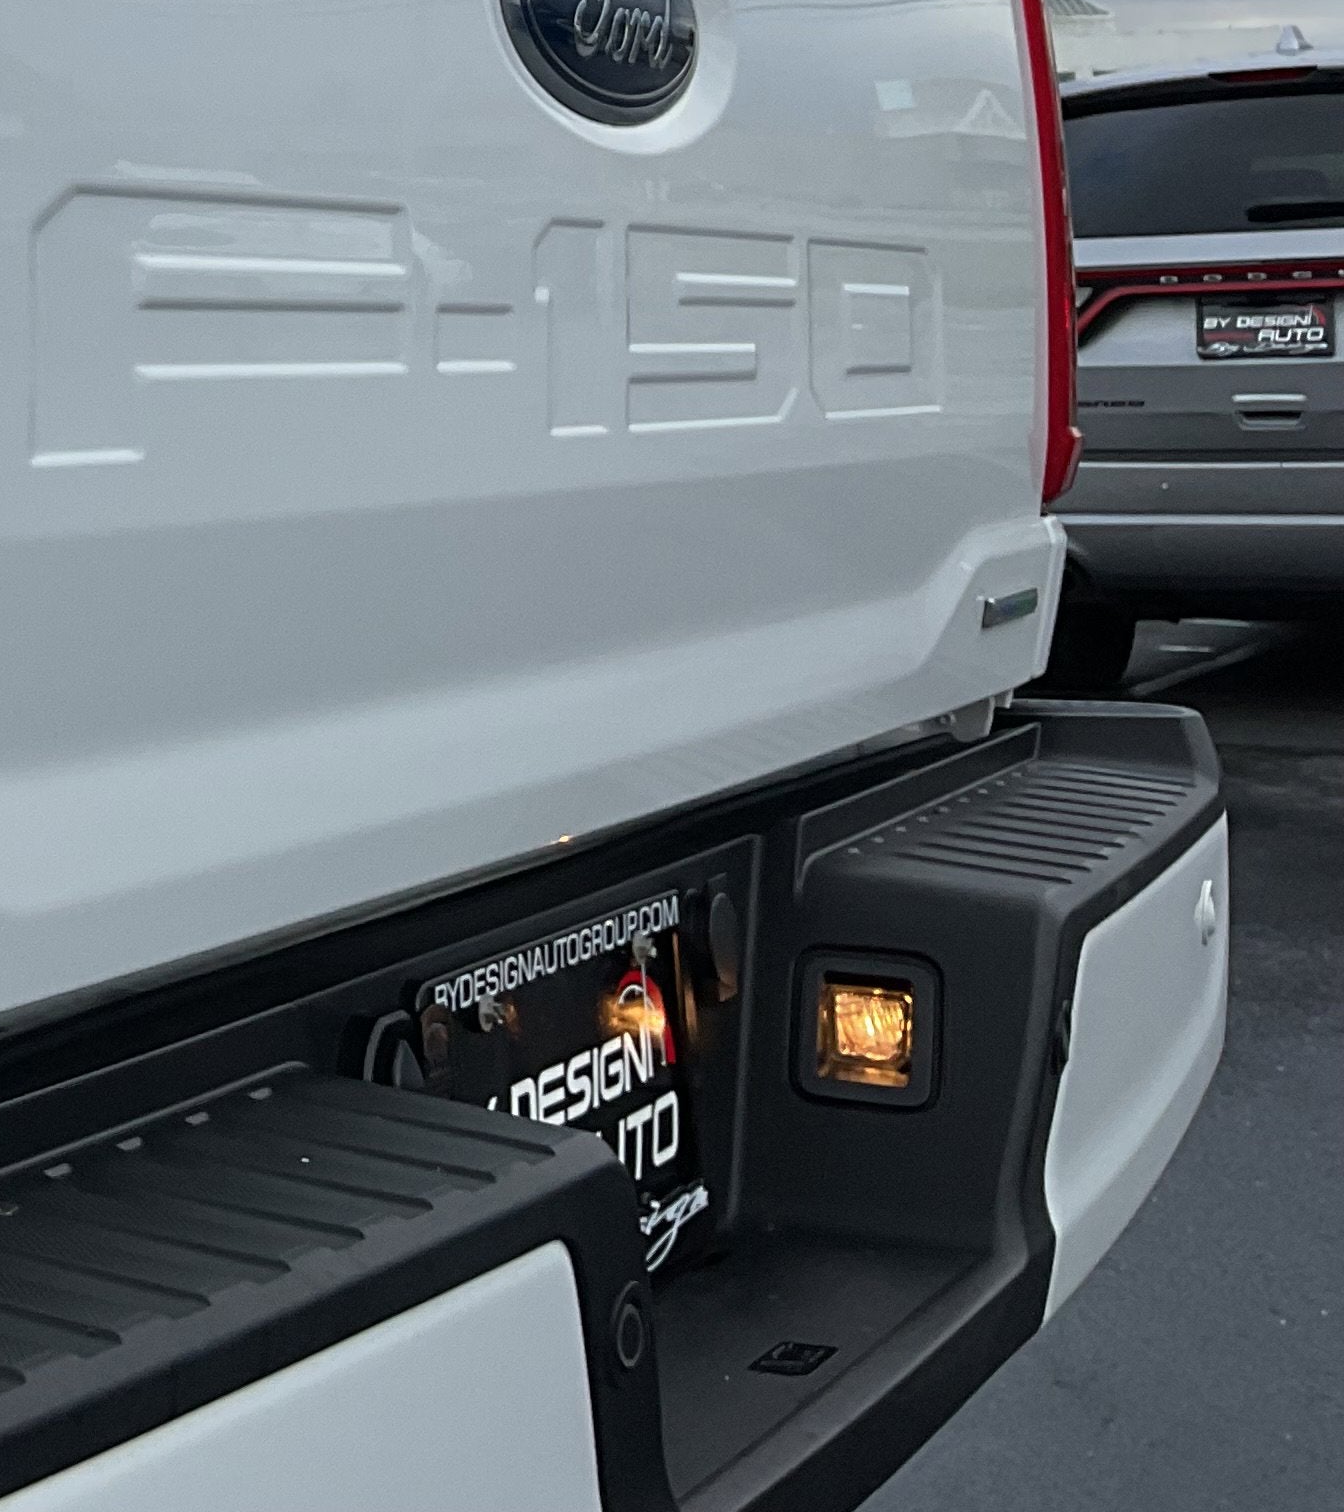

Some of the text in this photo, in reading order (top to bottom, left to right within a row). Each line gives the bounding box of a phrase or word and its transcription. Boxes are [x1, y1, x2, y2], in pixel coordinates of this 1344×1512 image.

[1203, 314, 1309, 329] BY DESIGN
[1258, 327, 1324, 342] AUTO
[434, 895, 679, 1012] BYDESIGNAUTOGROUPCOM
[510, 1025, 648, 1126] DESIGN
